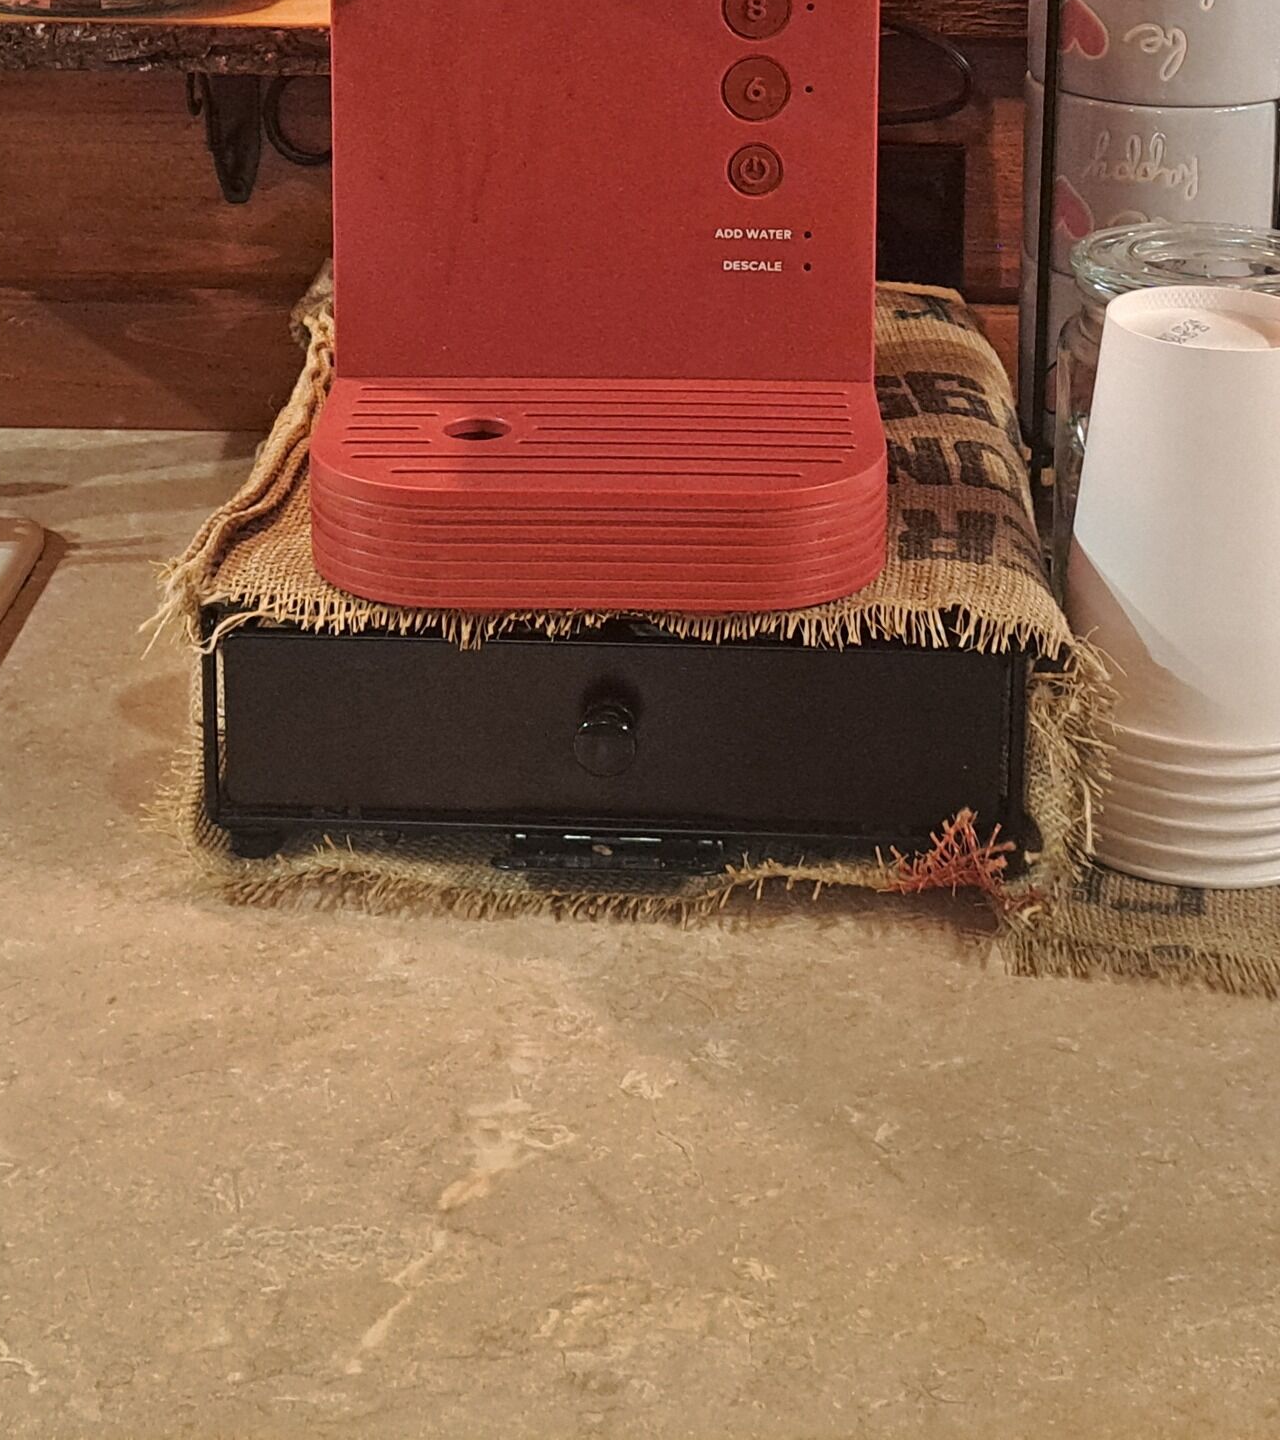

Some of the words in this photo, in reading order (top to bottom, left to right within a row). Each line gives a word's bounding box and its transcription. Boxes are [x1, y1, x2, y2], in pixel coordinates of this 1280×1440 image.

[1122, 22, 1188, 82] be
[745, 76, 767, 102] 6
[714, 227, 743, 239] ADD
[745, 228, 792, 240] WATER
[723, 260, 783, 272] DESCALE
